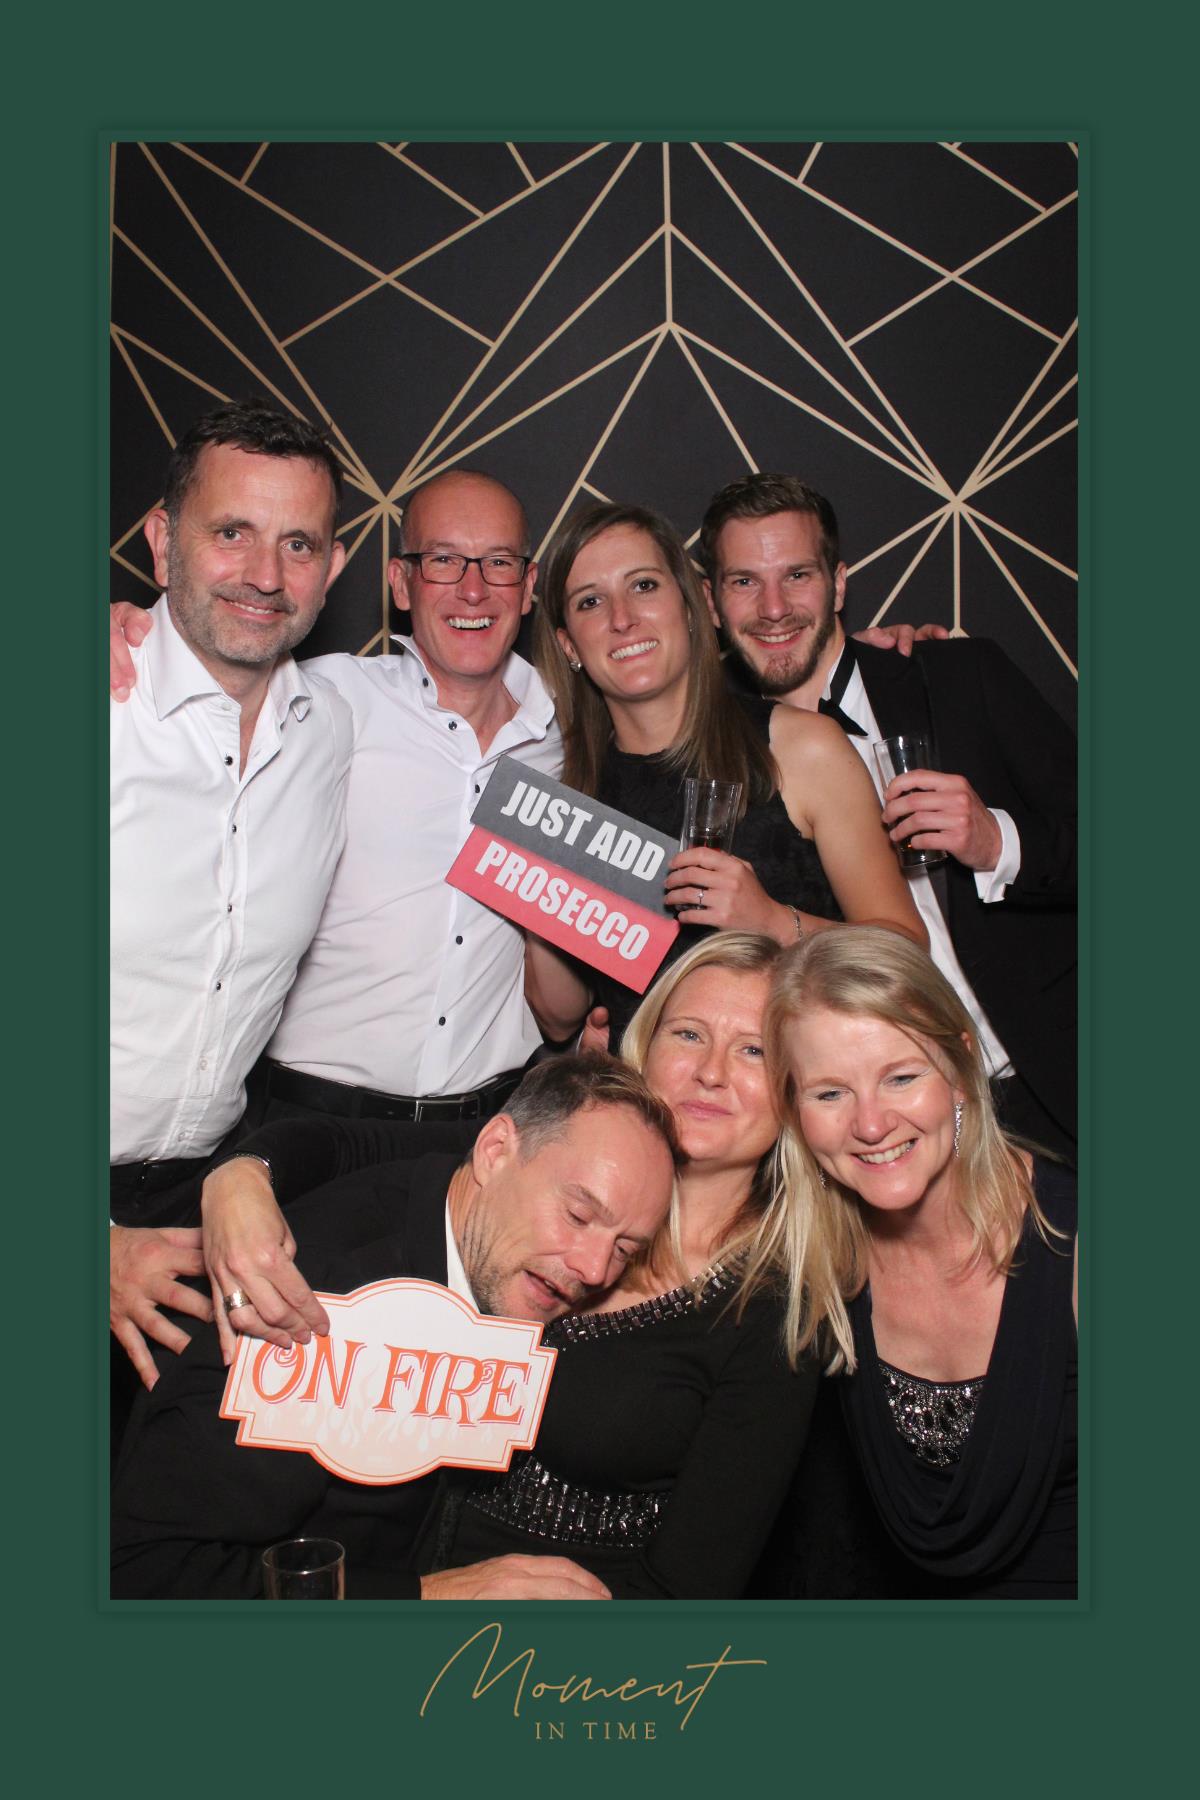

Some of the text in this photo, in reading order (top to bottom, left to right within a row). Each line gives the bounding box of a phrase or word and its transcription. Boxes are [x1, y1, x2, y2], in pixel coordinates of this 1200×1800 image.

[500, 780, 666, 881] JUST ADD
[474, 840, 650, 960] PROSECCO
[252, 1333, 531, 1427] ON FIRE
